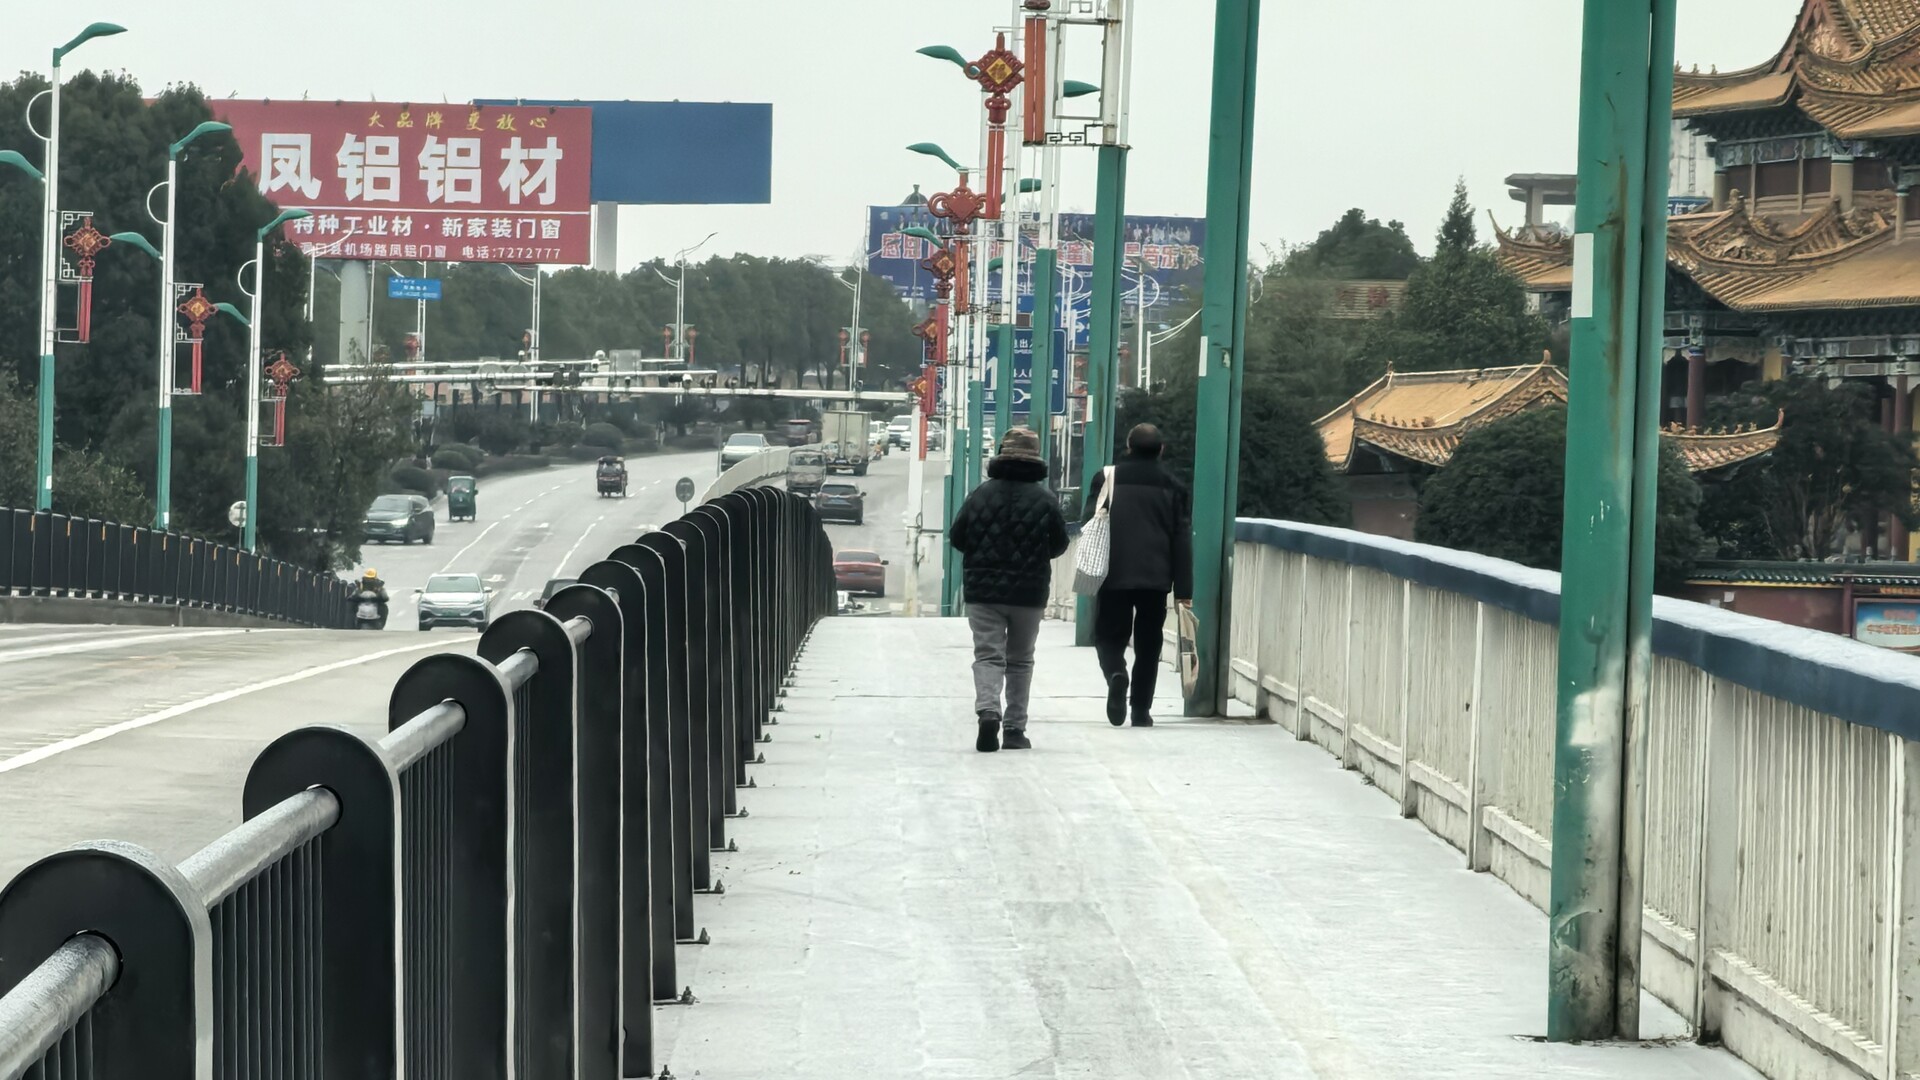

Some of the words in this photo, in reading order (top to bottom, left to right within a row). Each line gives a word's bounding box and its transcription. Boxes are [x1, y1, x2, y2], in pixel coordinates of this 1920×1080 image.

[368, 111, 444, 130] 大品牌
[466, 112, 548, 131] 更放心
[258, 131, 563, 206] 凤铝铝材
